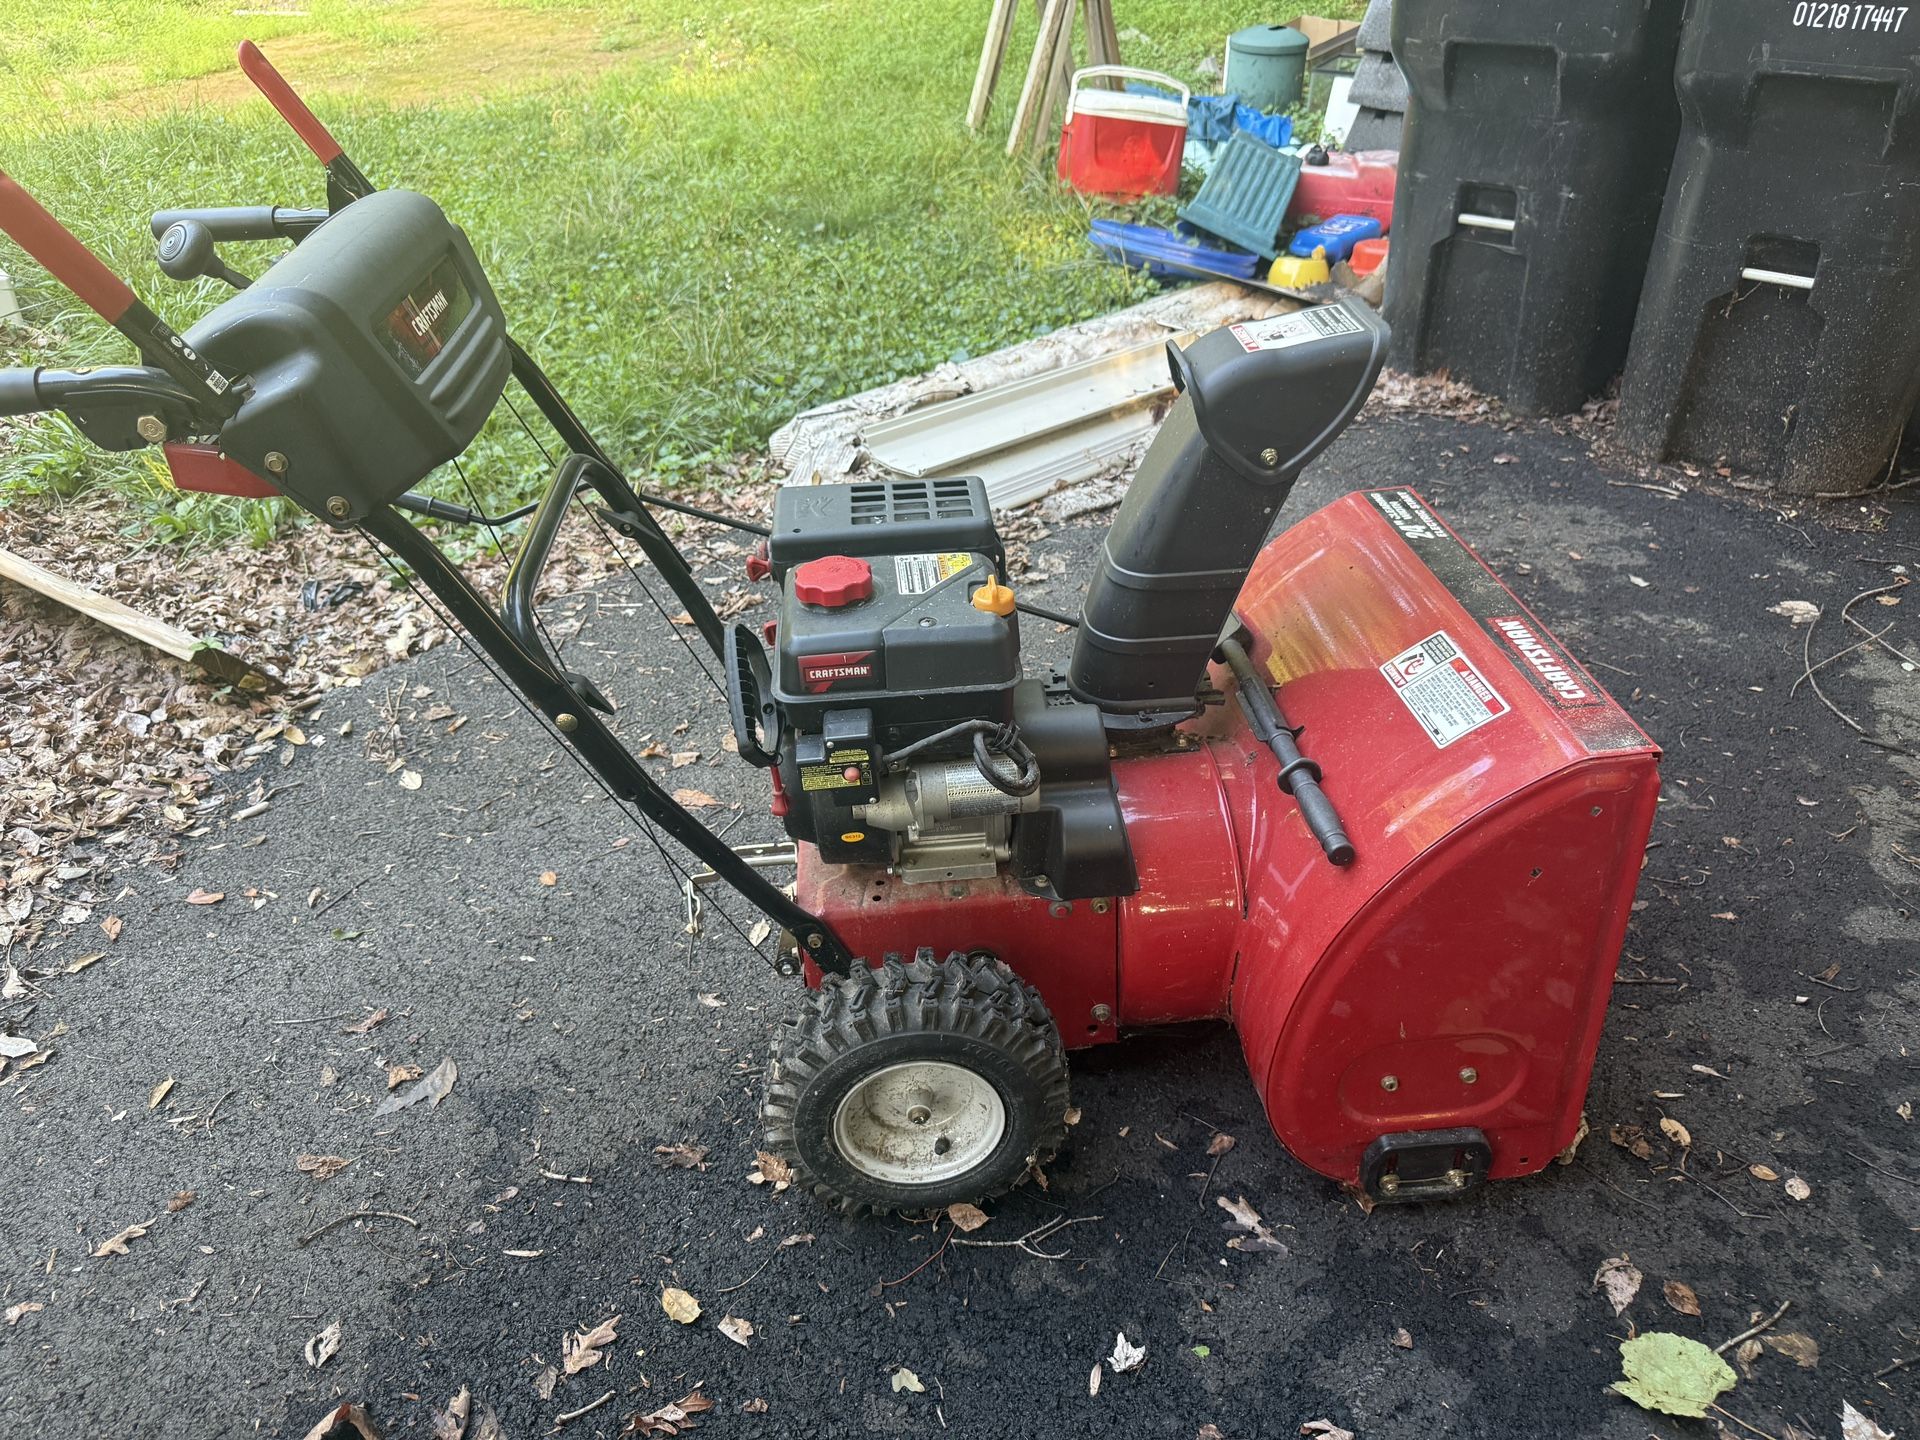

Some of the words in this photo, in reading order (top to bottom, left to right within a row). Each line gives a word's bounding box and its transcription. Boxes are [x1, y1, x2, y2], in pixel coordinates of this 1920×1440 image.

[411, 290, 448, 337] CRAFTSMAN
[1396, 491, 1420, 509] START
[1414, 510, 1448, 537] ELECTRIC
[809, 667, 868, 679] CRAFTSMAN
[1496, 620, 1586, 699] CRAFTSMAN
[1464, 674, 1494, 702] DANGER
